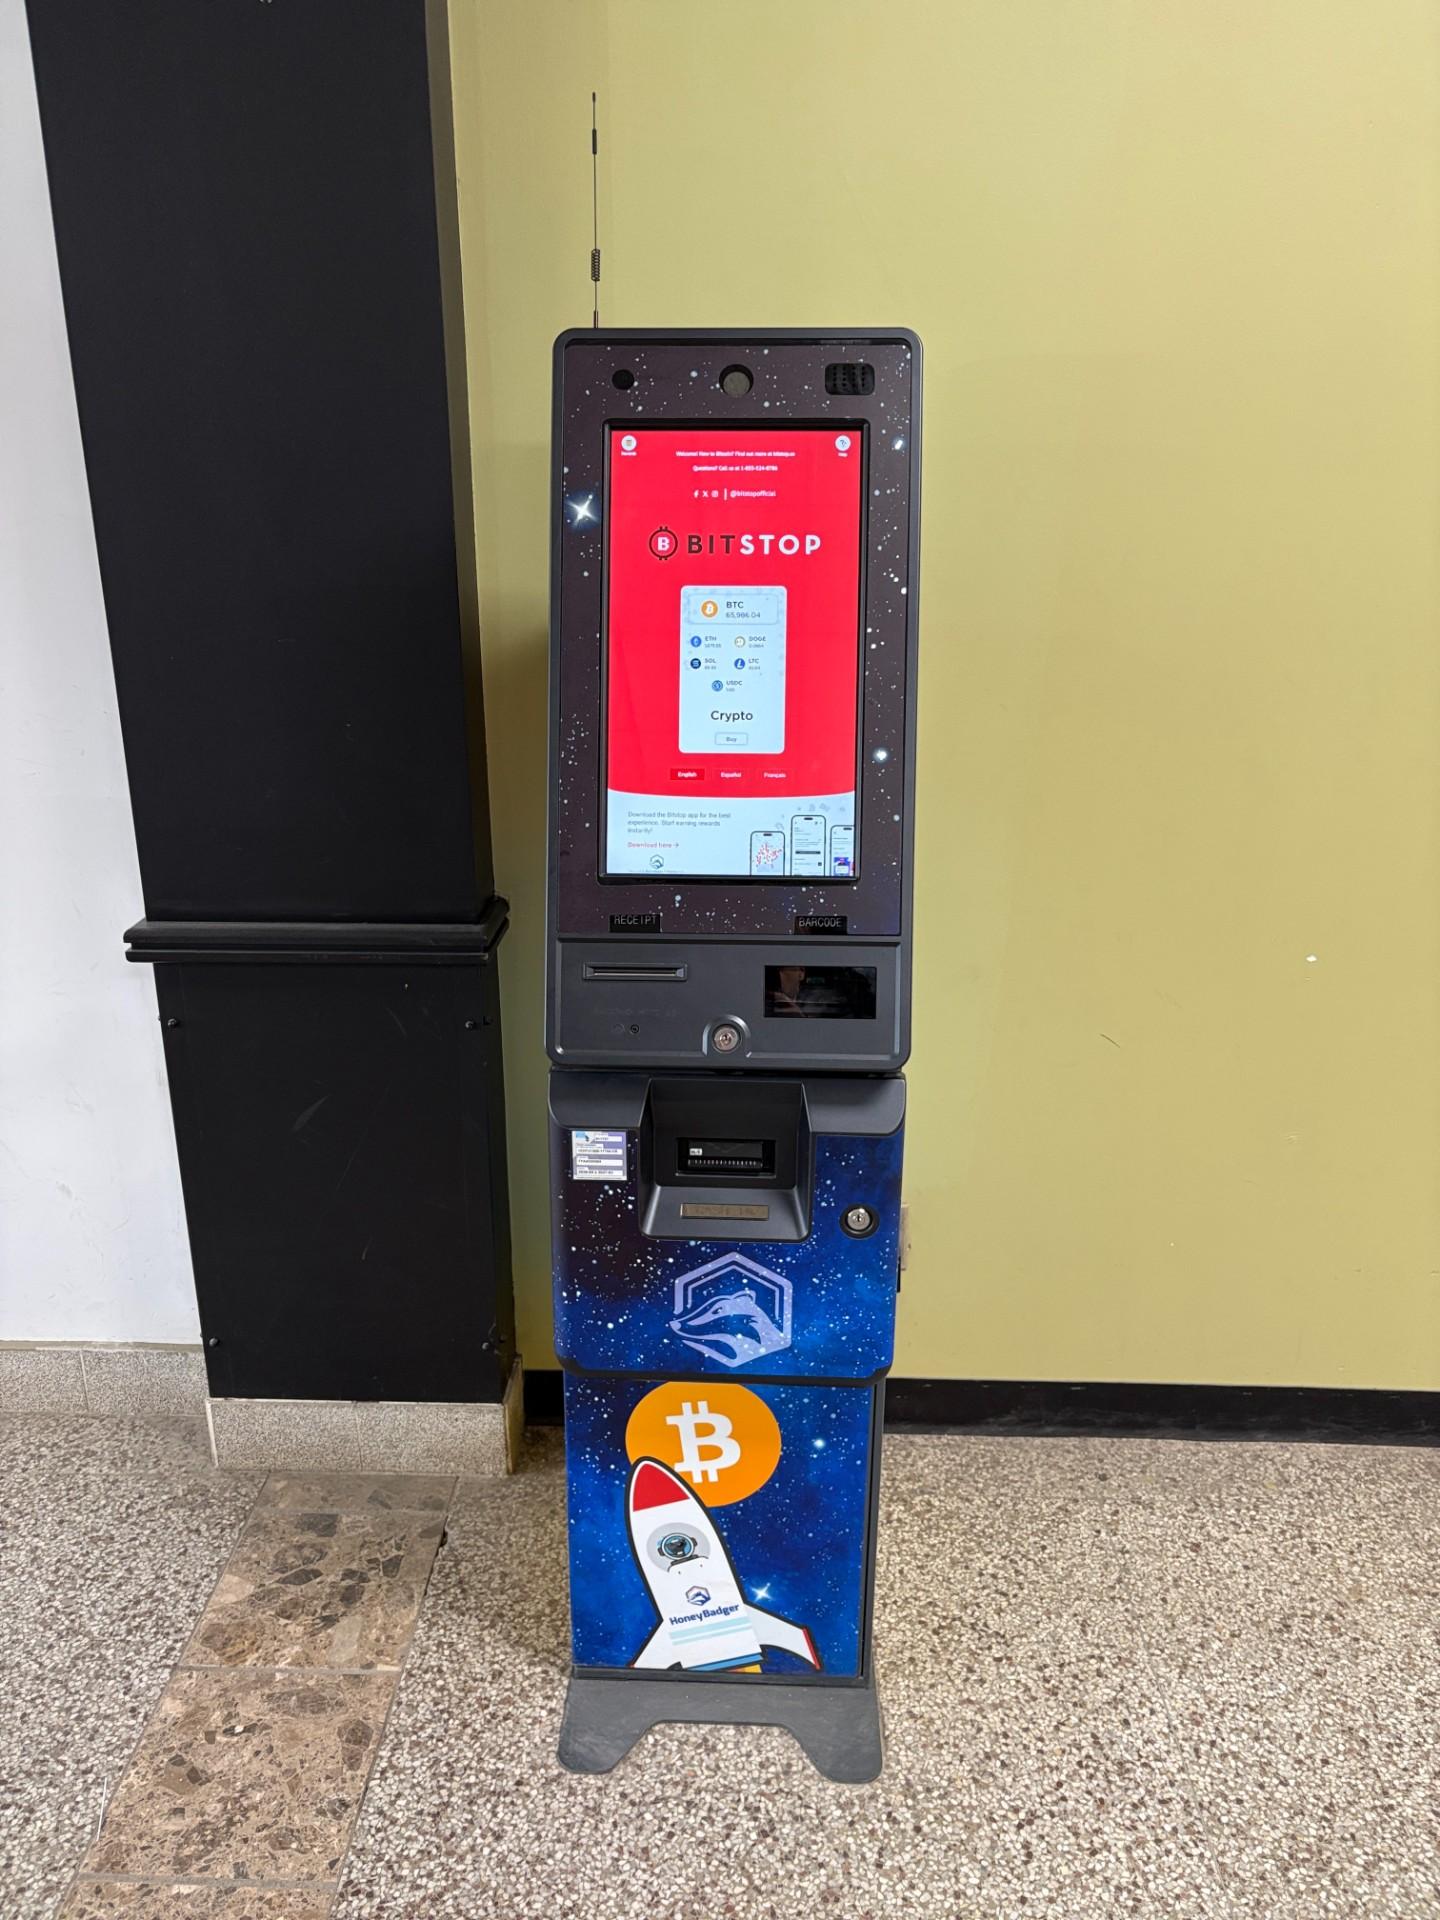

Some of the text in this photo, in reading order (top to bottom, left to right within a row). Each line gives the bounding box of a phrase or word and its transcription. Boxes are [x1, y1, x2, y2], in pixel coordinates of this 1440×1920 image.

[688, 534, 822, 556] BITSTOP
[726, 601, 744, 609] BTC
[710, 710, 754, 723] Crypto
[677, 771, 697, 779] English
[614, 915, 657, 925] RECEIPT
[798, 917, 842, 928] BARCODE
[669, 1604, 740, 1626] HoneyBadger
